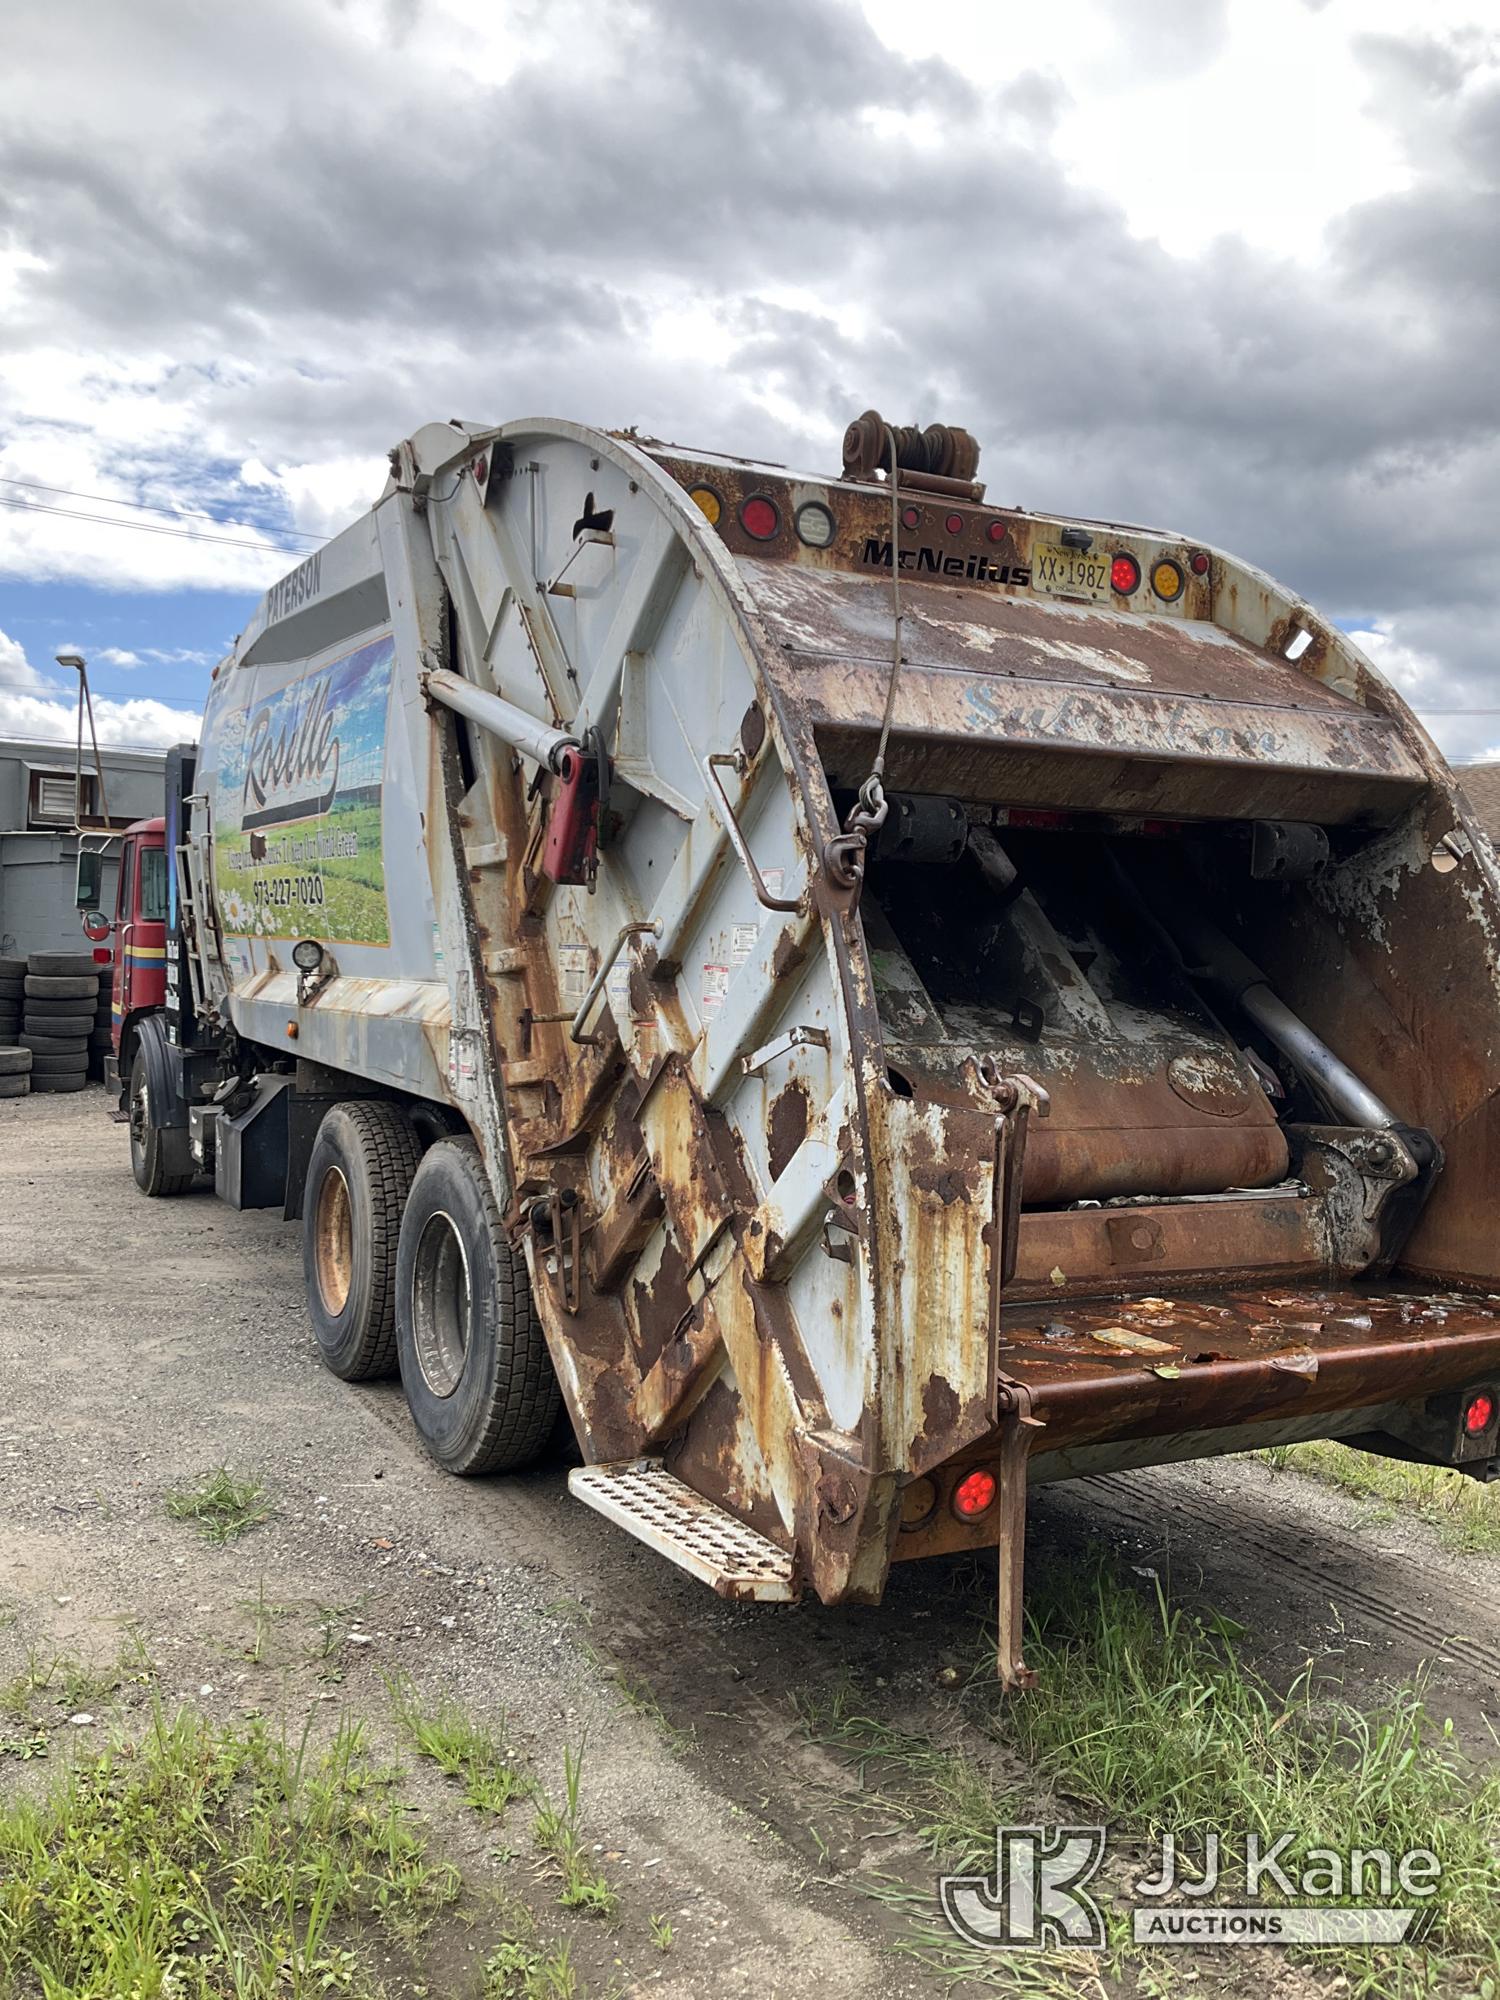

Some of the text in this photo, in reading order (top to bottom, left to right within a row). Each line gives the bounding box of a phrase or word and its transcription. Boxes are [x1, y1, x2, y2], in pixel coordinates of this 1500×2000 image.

[267, 550, 321, 626] PATERSON
[863, 538, 1031, 587] McNeilus
[243, 675, 340, 808] Roselle
[253, 875, 323, 905] 973-227-7020
